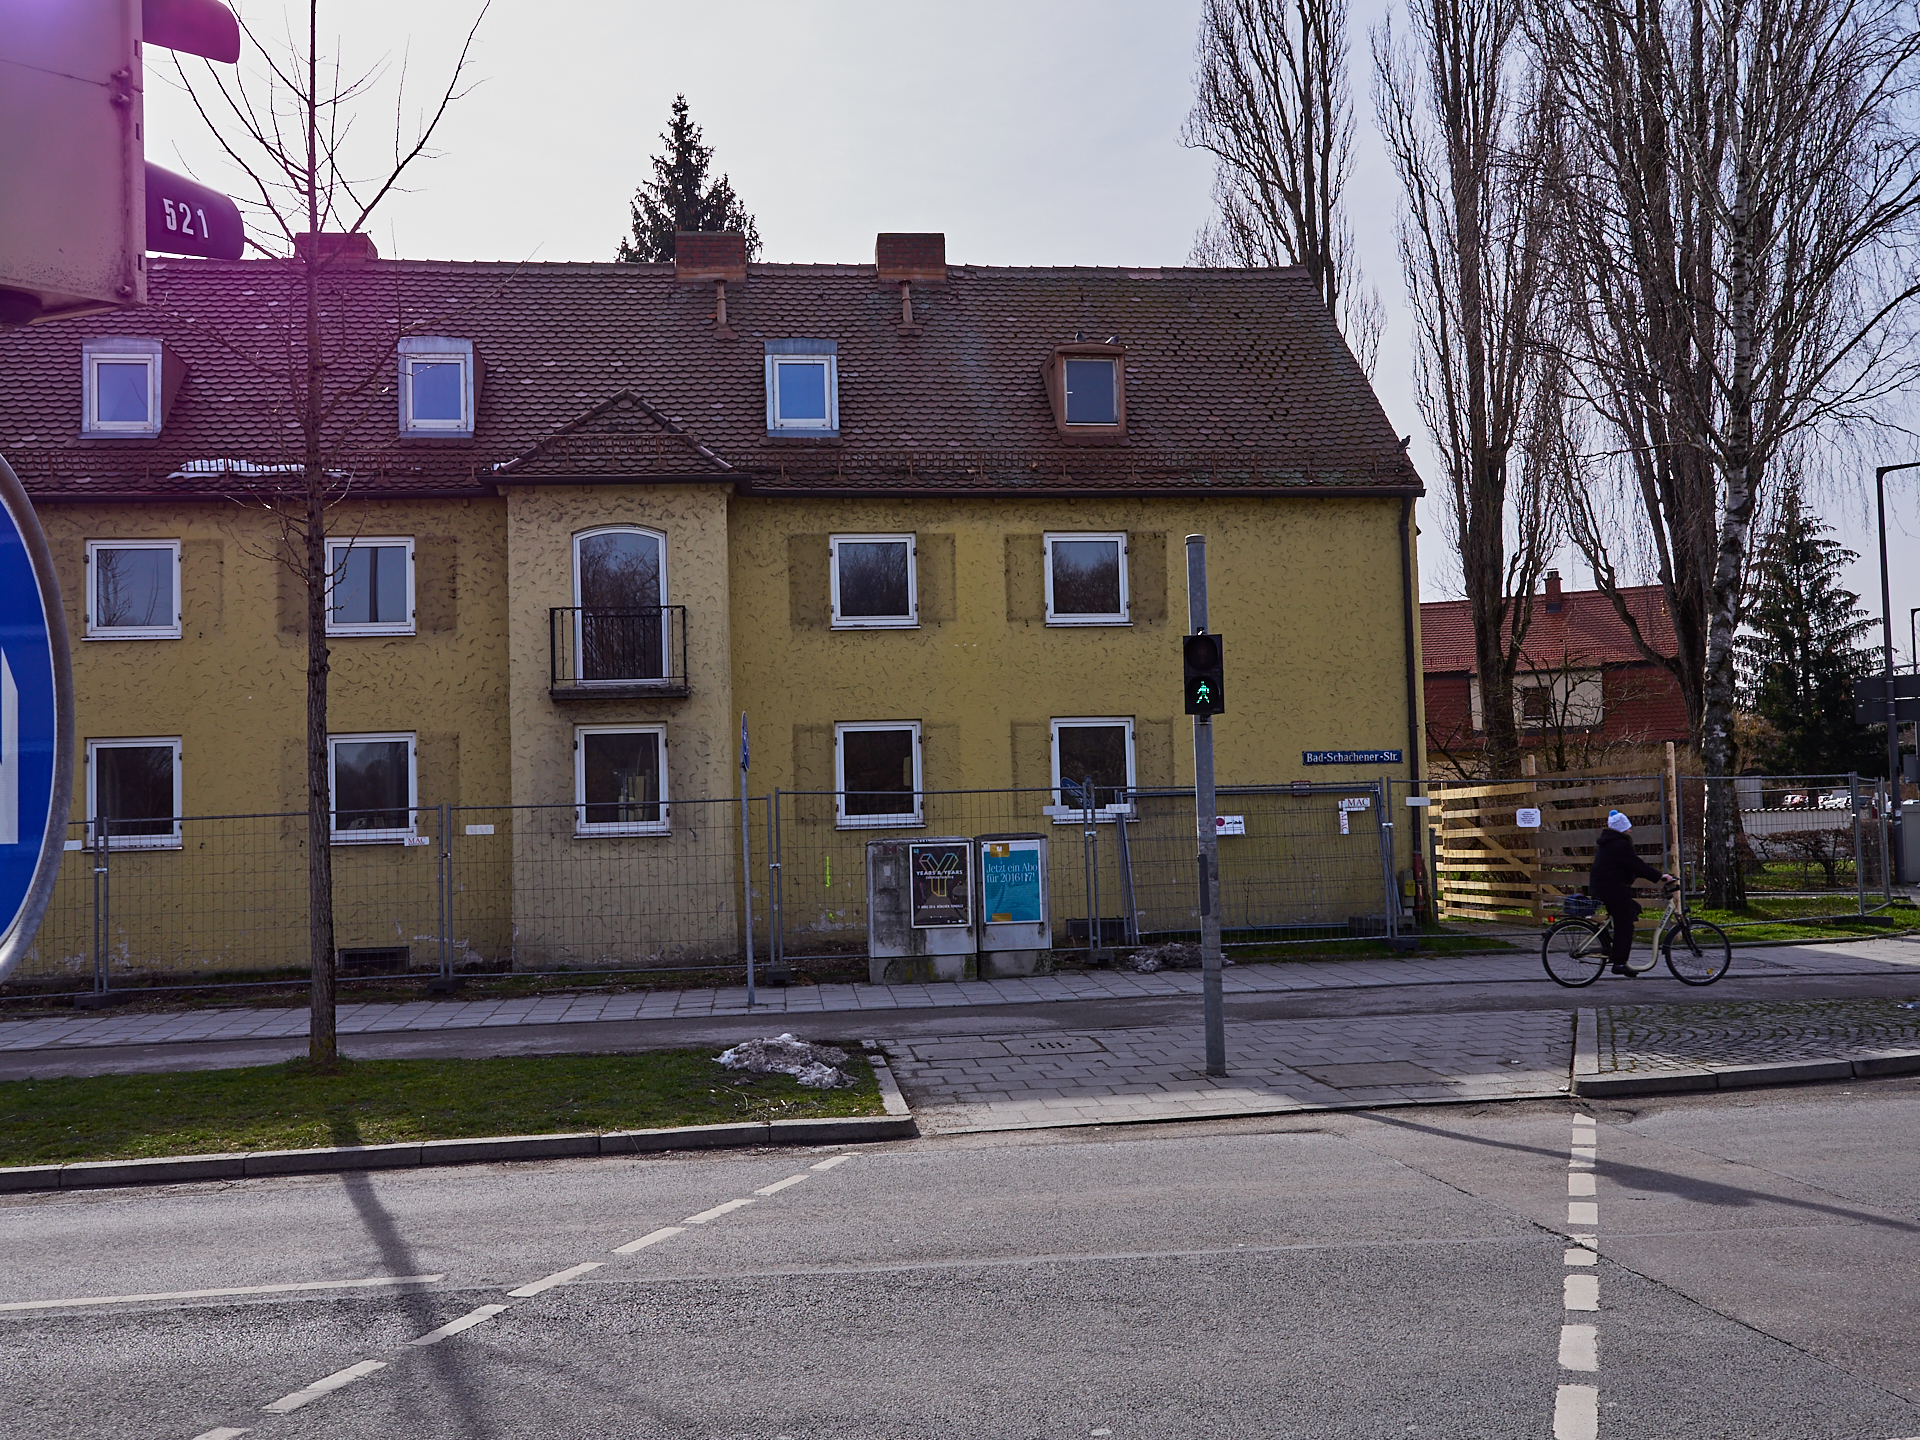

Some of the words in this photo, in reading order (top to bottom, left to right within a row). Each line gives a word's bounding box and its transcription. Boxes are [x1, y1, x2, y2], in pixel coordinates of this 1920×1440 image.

[162, 197, 209, 239] 521
[1347, 798, 1369, 806] MAC
[986, 863, 1006, 873] Jetzt
[1007, 862, 1020, 872] ein
[1022, 862, 1038, 872] Abo
[986, 873, 999, 883] für
